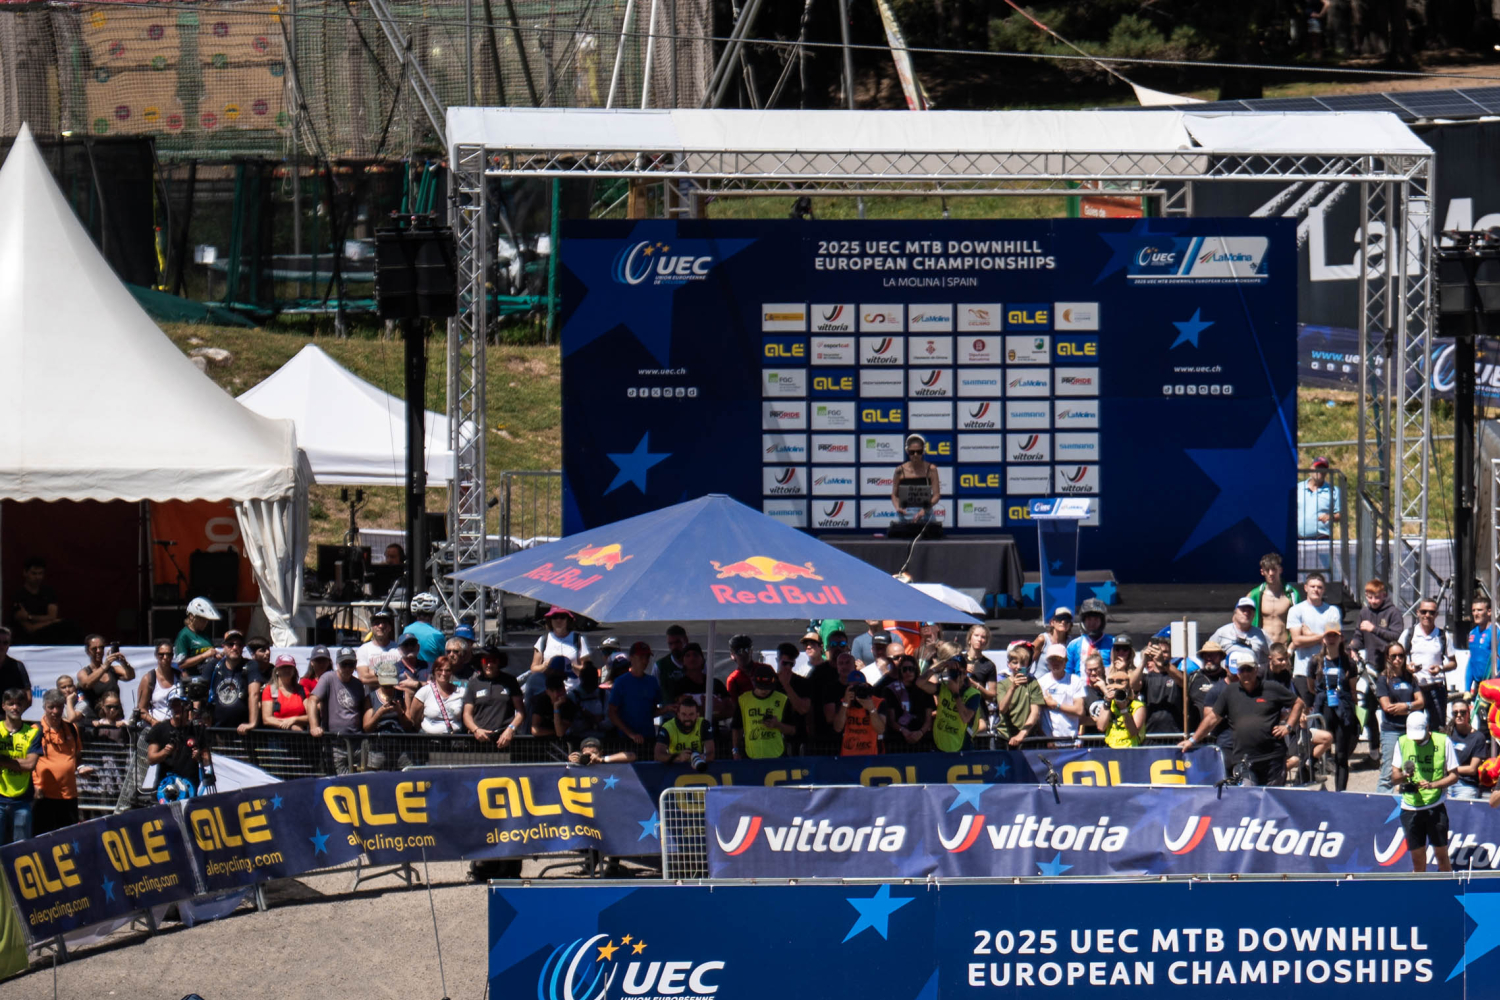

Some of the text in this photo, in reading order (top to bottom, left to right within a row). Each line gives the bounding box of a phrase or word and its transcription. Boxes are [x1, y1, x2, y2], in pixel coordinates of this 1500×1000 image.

[818, 240, 1042, 254] 2025 UEC MTB DOWNHILL
[656, 256, 712, 275] UEC
[814, 256, 1056, 270] EUROPEAN CHAMPIONSHIPS
[1152, 252, 1176, 262] UEC
[883, 277, 978, 287] LA MOLINA SPAIN
[817, 324, 848, 332] vittoria
[638, 368, 686, 376] www.uec.ch
[1174, 365, 1222, 374] www.uec.ch
[915, 388, 946, 396] vittoria
[818, 518, 850, 526] vittoria
[711, 584, 848, 605] Red Bull
[486, 822, 601, 844] alecycling.com
[764, 816, 906, 852] vittoria
[986, 813, 1130, 852] vittoria
[1212, 816, 1345, 858] vittoria
[206, 850, 282, 876] alecycling.com
[974, 926, 1428, 954] 2025 UEC MTB DOWNHILL
[622, 961, 726, 994] UEC
[968, 958, 1434, 986] EUROPEAN CHAMPIOSHIPS
